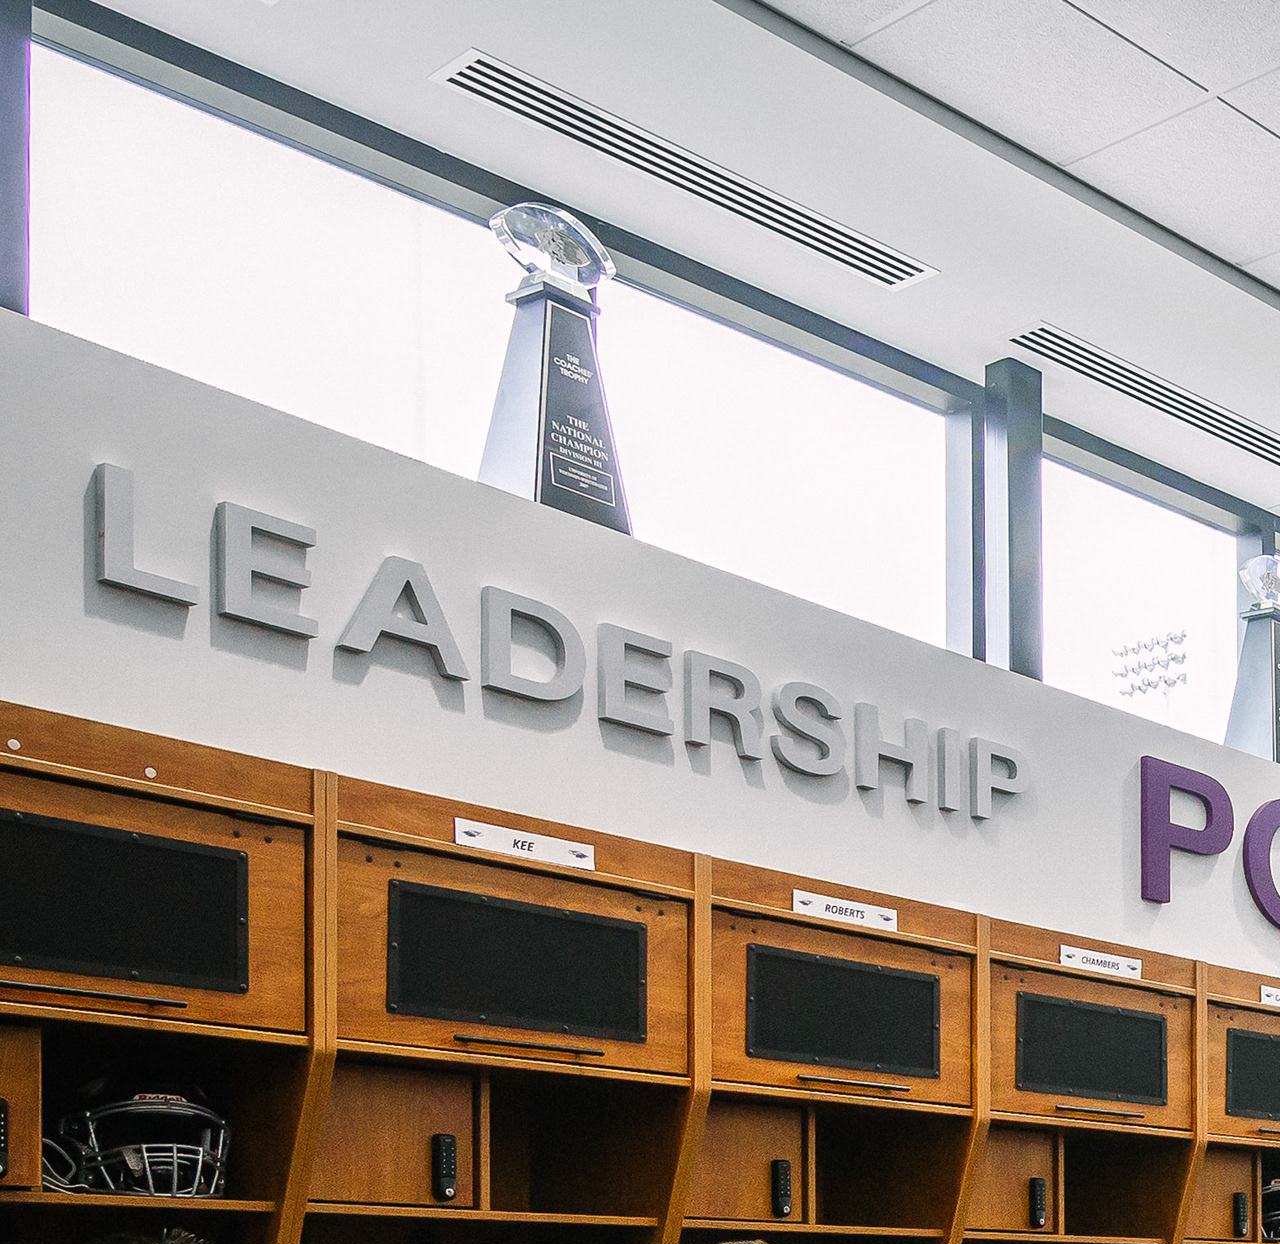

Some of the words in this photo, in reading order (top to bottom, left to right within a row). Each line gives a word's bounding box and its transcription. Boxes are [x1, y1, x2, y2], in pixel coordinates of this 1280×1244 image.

[566, 353, 580, 365] THE
[560, 367, 589, 385] TROPHY
[566, 415, 589, 432] THE
[551, 420, 606, 449] NATIONAL
[551, 432, 609, 462] CHAMPION
[559, 446, 592, 466] DIVISION
[95, 462, 1031, 820] LEADERSHIP
[512, 838, 535, 853] KEE
[824, 902, 866, 920] ROBERTS
[1081, 955, 1120, 972] CHAMBERS
